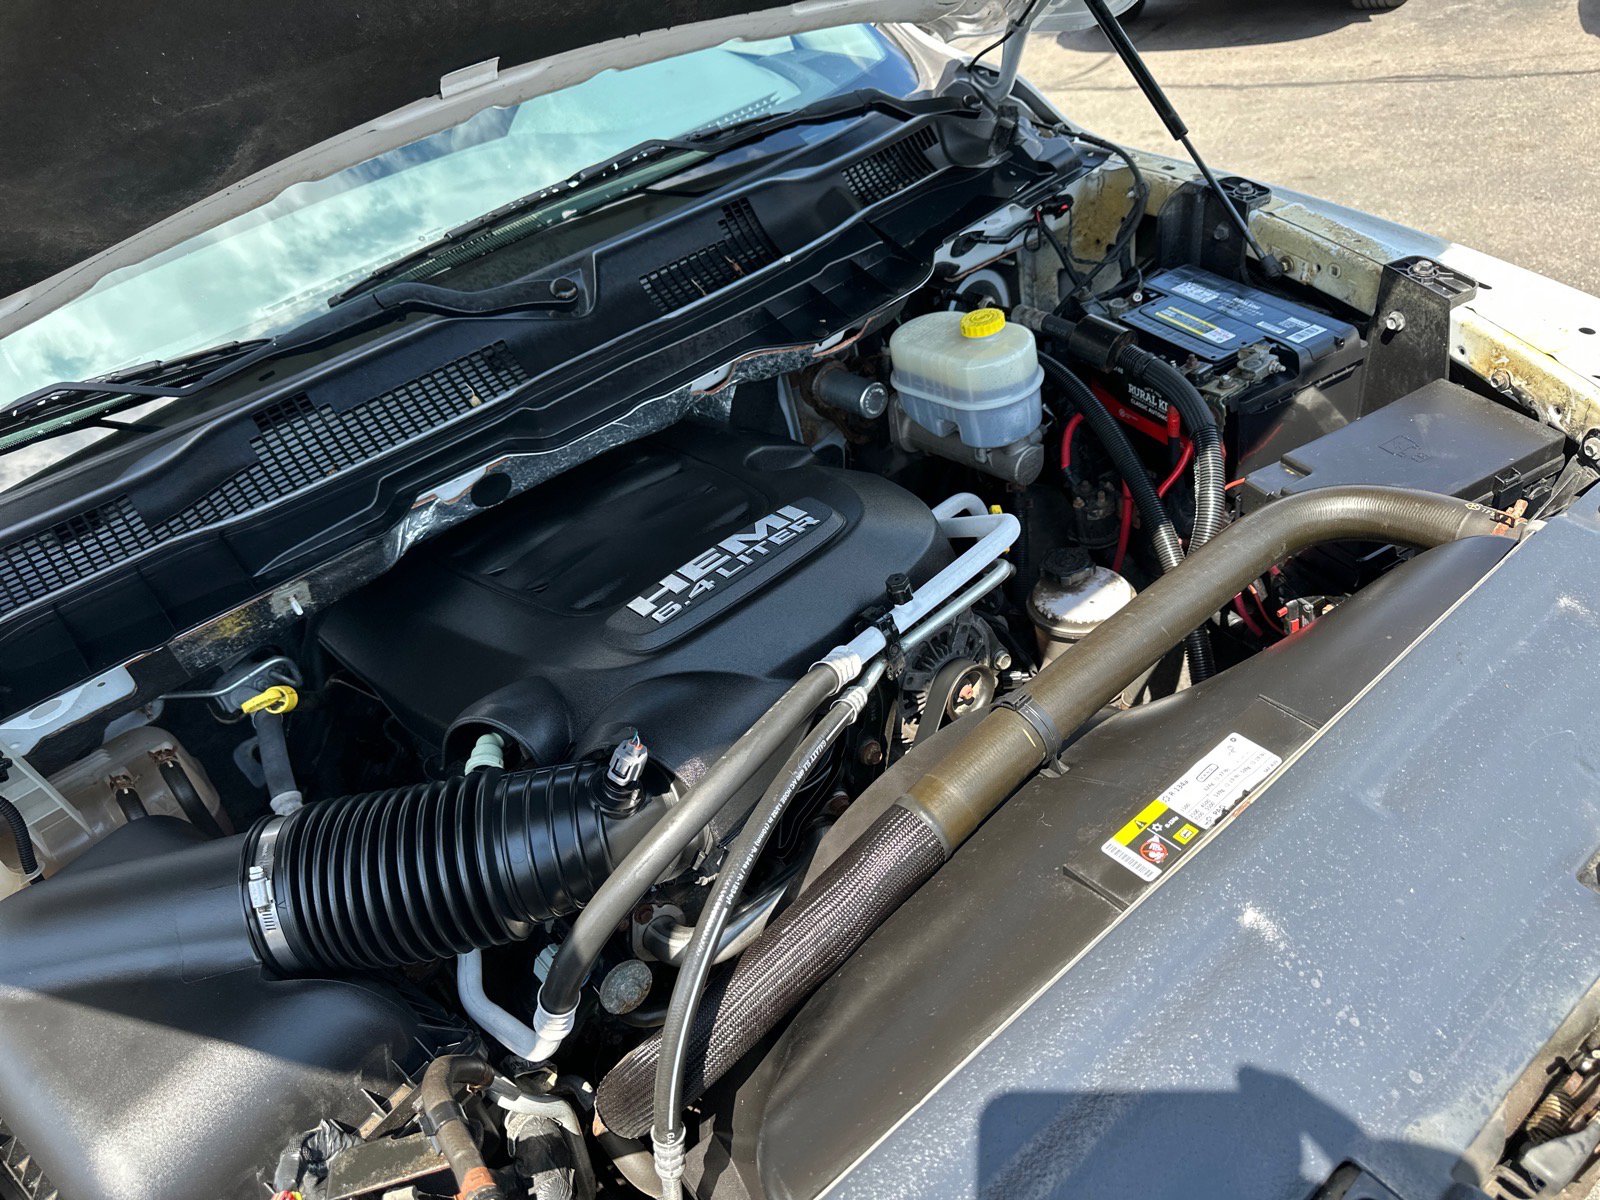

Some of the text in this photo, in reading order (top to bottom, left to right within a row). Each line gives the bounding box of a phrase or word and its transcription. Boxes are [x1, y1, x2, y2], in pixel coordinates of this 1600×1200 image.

[1128, 384, 1157, 406] RURAL
[1157, 399, 1169, 411] KI
[626, 505, 808, 617] HEMI
[652, 516, 821, 624] 6.4 LITER
[808, 739, 827, 761] GALAXY
[779, 787, 792, 803] HOSE
[788, 778, 797, 789] A/C
[753, 822, 770, 846] (10mm)
[741, 845, 758, 869] R-134a
